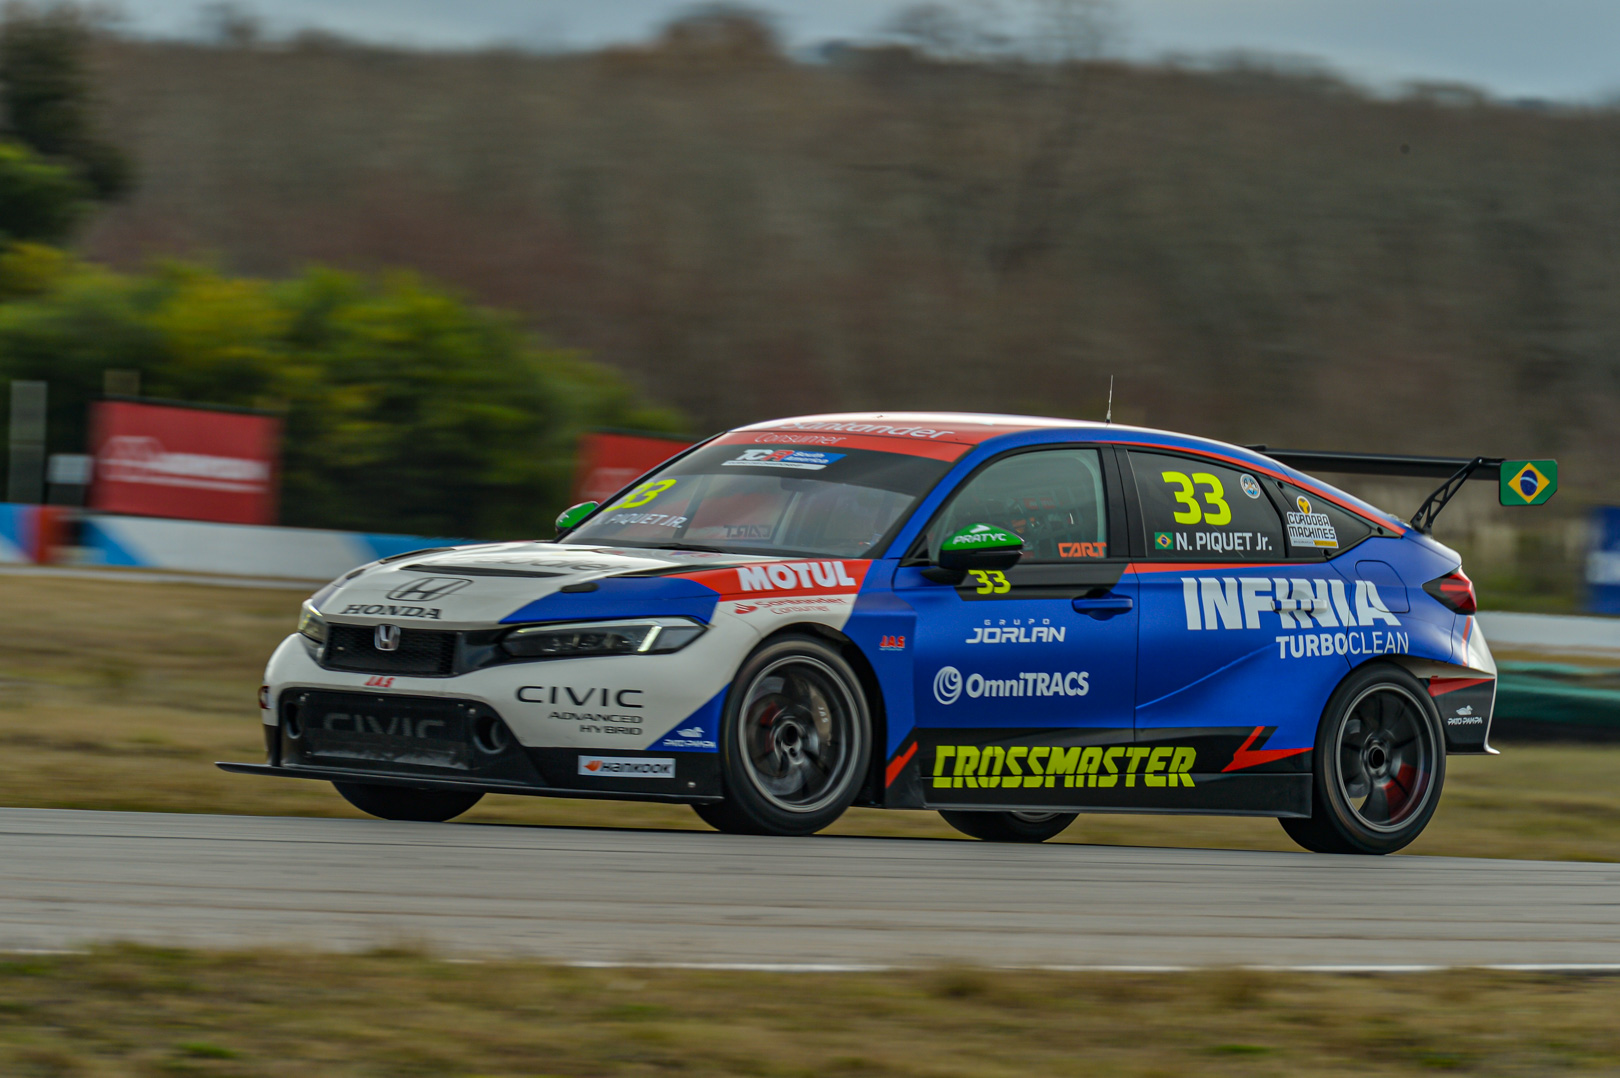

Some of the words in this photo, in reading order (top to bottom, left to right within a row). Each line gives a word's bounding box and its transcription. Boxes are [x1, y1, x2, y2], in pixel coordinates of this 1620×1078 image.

[755, 432, 847, 445] Consumer
[780, 422, 954, 439] Santander
[735, 449, 795, 462] TCR
[602, 478, 677, 512] 33
[1161, 471, 1232, 526] 33
[953, 532, 1007, 545] PRATYC
[1288, 526, 1336, 540] MACHINES
[1057, 542, 1107, 558] CART
[1175, 532, 1193, 550] N.
[1196, 532, 1253, 553] PIQUET
[1256, 532, 1273, 550] Jr.
[736, 561, 856, 591] MOTUL
[967, 569, 1011, 595] 33
[755, 596, 847, 607] Santander
[770, 605, 830, 614] Consumer
[1180, 577, 1402, 630] INFINIA
[341, 604, 442, 619] HONDA
[879, 635, 905, 648] JAS
[965, 626, 1067, 644] JORLAN
[1275, 631, 1409, 660] TURBOCLEAN
[364, 676, 395, 688] JAS
[966, 671, 1090, 698] OmniTRACS
[517, 686, 644, 708] CIVIC
[549, 711, 643, 724] ADVANCED
[580, 725, 643, 736] HYBRID
[932, 745, 1197, 788] CROSSMASTER
